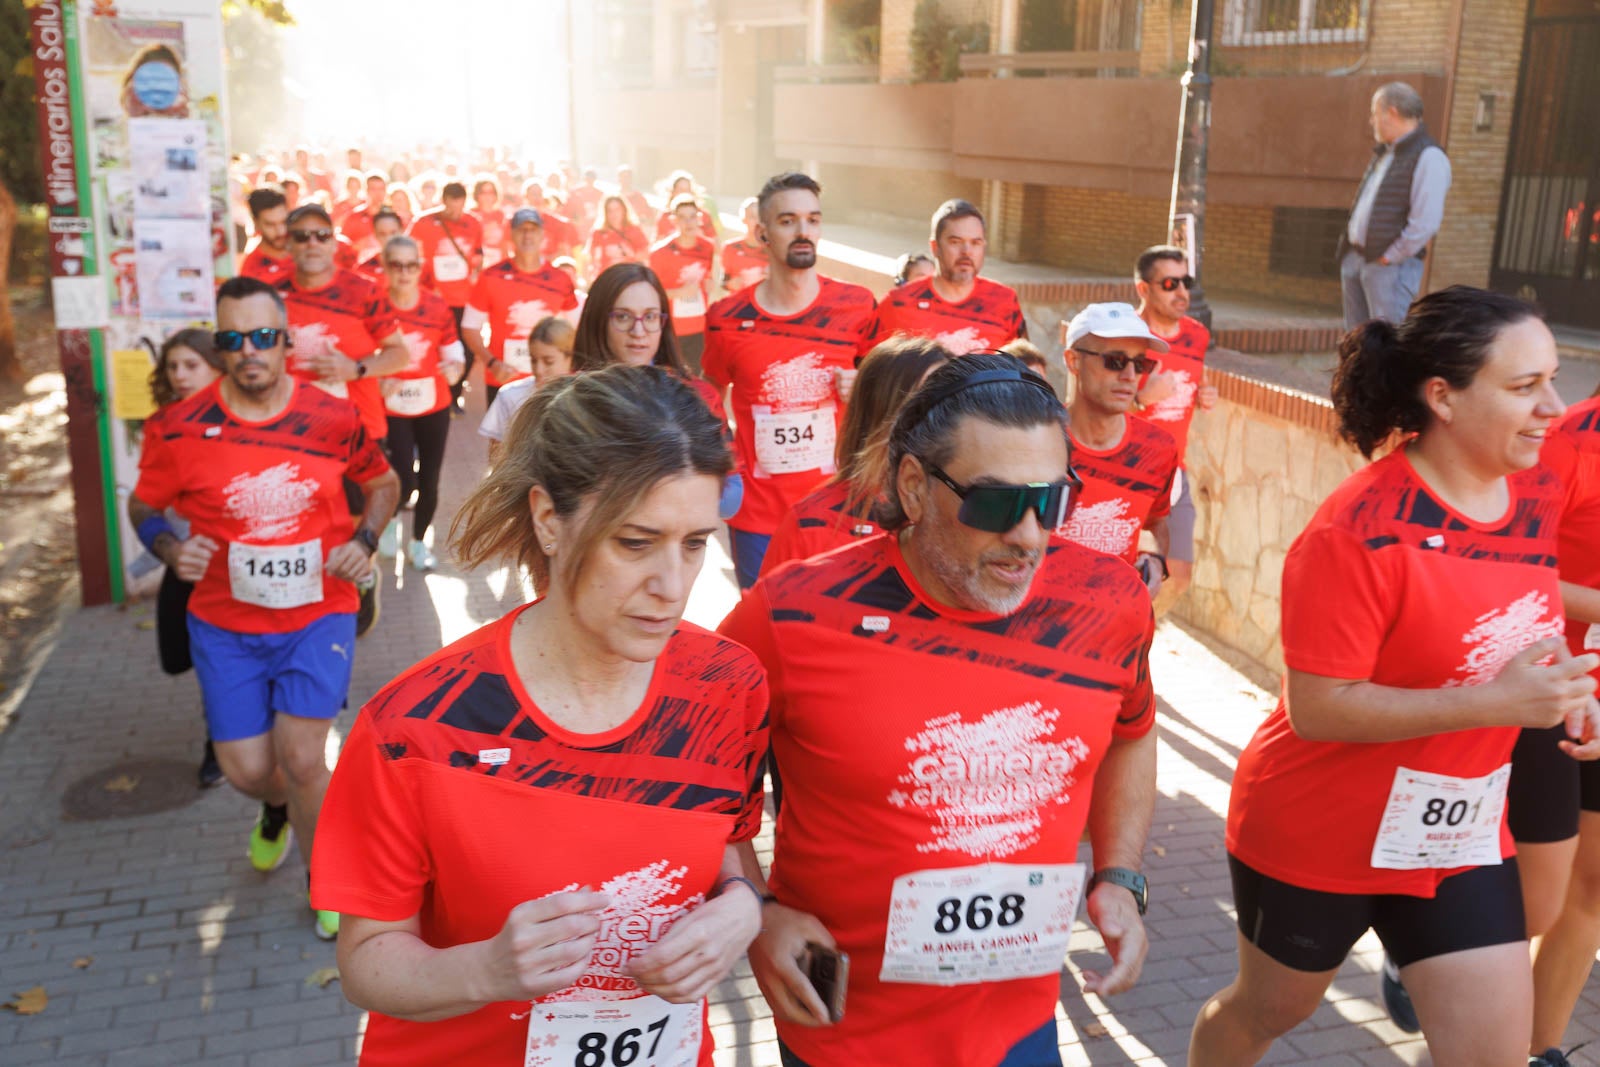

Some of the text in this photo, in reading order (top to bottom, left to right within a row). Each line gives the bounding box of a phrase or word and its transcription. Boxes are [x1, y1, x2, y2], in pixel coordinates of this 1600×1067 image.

[34, 0, 65, 61] Salu
[774, 423, 814, 445] 534
[245, 557, 307, 578] 1438
[912, 750, 1072, 784] carrera
[1422, 796, 1484, 826] 801
[934, 893, 1026, 934] 868
[575, 1014, 671, 1067] 867
